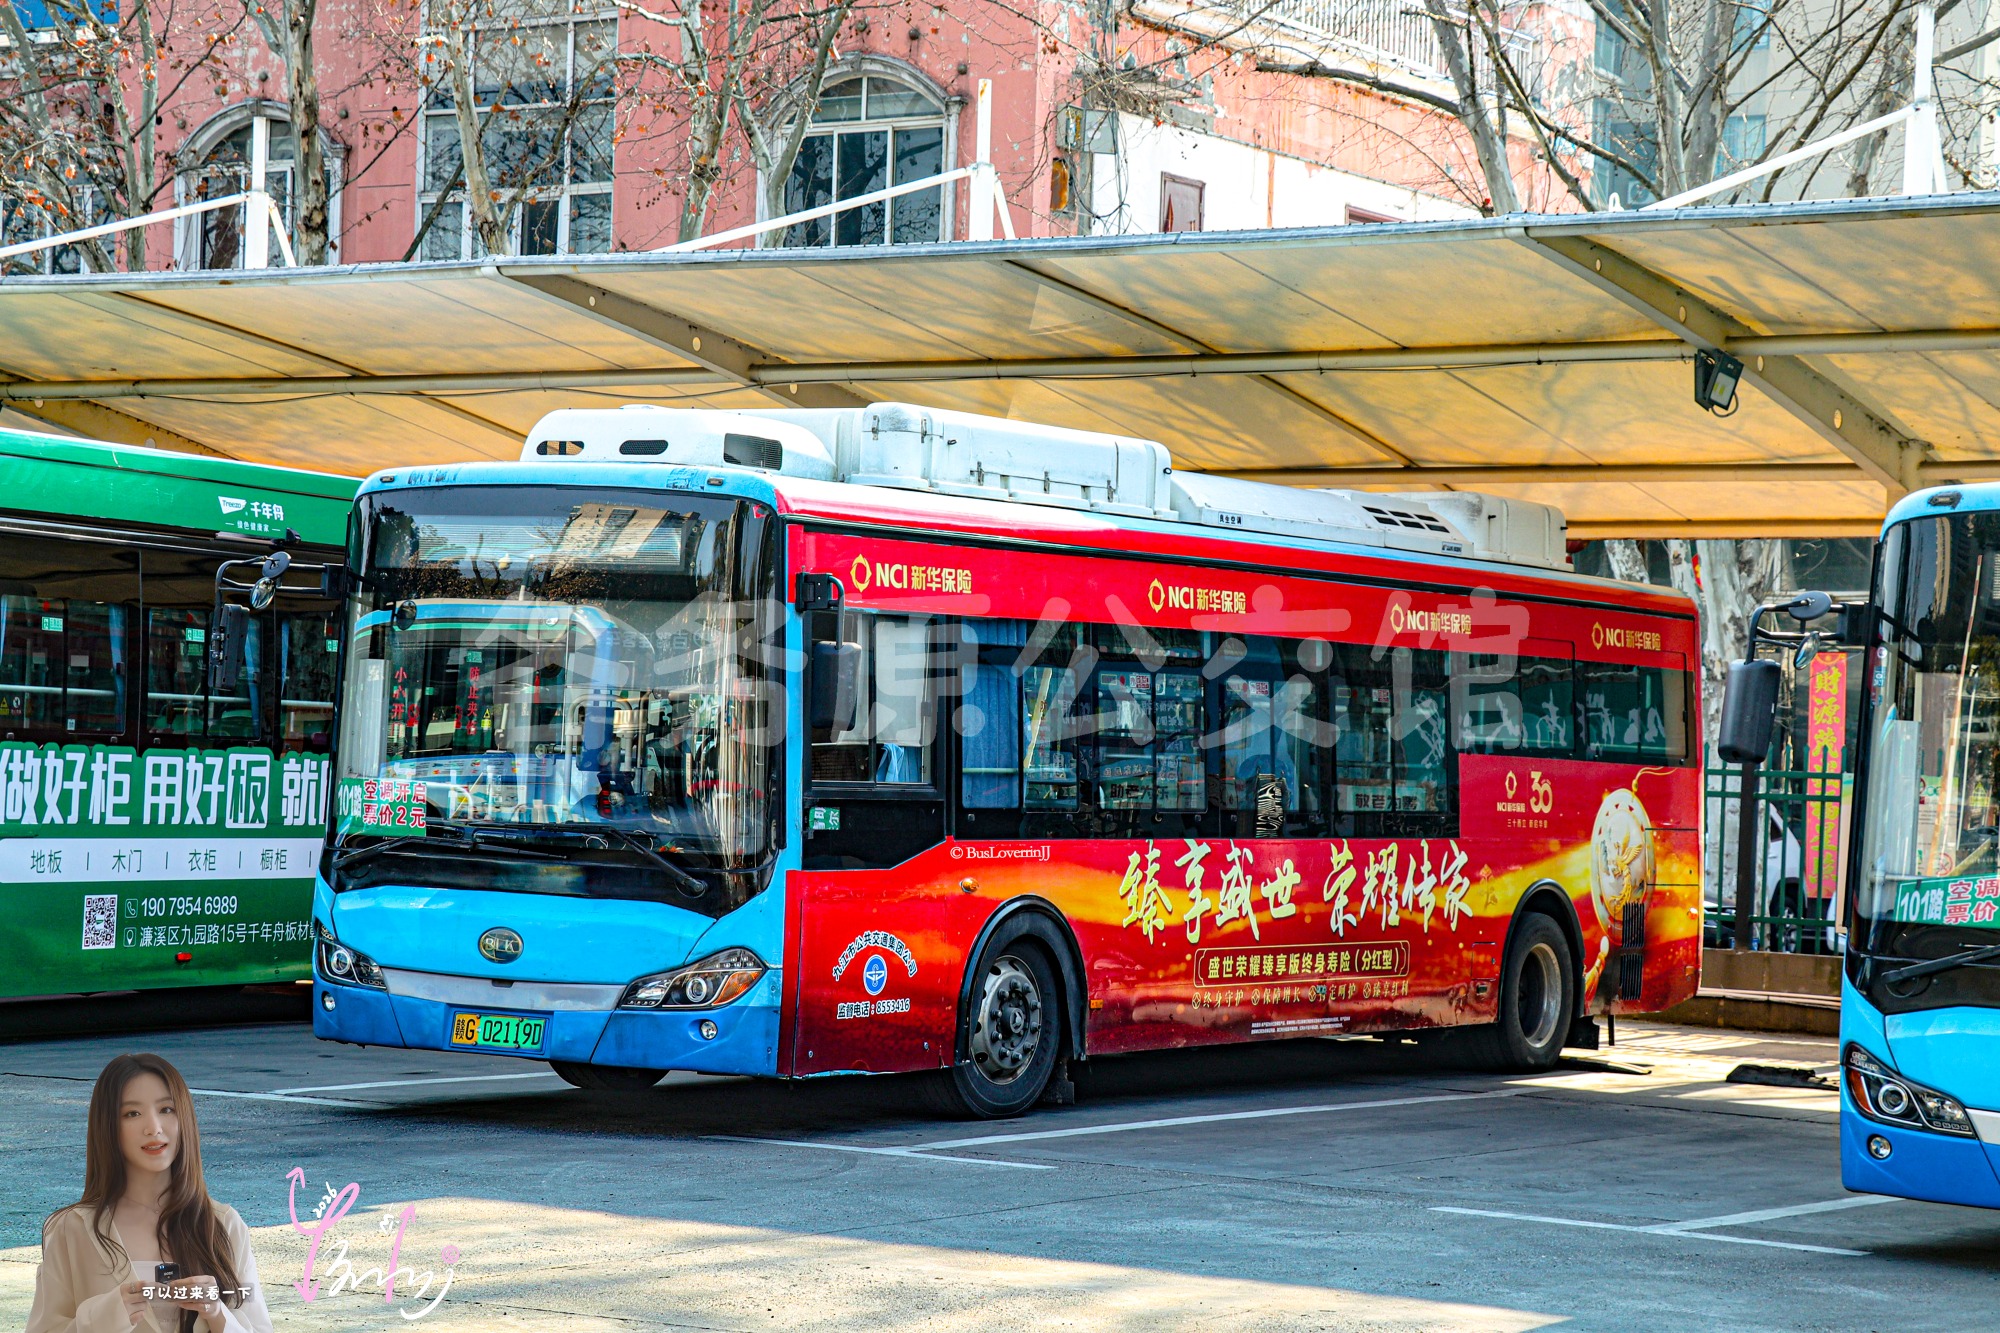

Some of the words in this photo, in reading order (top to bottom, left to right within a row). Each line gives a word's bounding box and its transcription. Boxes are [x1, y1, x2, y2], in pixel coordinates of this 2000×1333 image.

[250, 501, 284, 521] 千年舟
[876, 562, 908, 589] NCI
[911, 565, 972, 594] 新华保险
[1168, 585, 1194, 610] NCI
[1196, 588, 1247, 615] 新华保险
[1407, 609, 1429, 631] NCI
[1430, 612, 1472, 635] 新华保险
[1605, 627, 1625, 648] NCI
[1625, 630, 1661, 651] 新华保险
[0, 748, 133, 825] 做好柜
[143, 753, 271, 829] 用好板
[281, 757, 330, 826] 就
[338, 784, 362, 818] 101路
[364, 779, 427, 804] 空调开启
[363, 803, 426, 828] 票价2元
[30, 849, 62, 874] 地板
[112, 849, 142, 873] 木门
[188, 849, 217, 872] 衣柜
[260, 848, 288, 871] 橱柜
[1119, 838, 1301, 945] 臻享盛世
[1323, 838, 1473, 938] 荣耀传家
[1948, 879, 2000, 901] 空调
[141, 897, 166, 917] 190
[169, 896, 201, 916] 7954
[204, 896, 238, 915] 6989
[1900, 888, 1945, 922] 101路
[1944, 901, 1999, 925] 票价
[485, 938, 515, 953] BLK
[832, 930, 918, 982] 九江市公共交通集团公司
[1207, 950, 1351, 979] 盛世荣耀臻享版终身寿险
[1203, 989, 1244, 1008] 终身守护
[1263, 986, 1301, 1004] 保障增长
[482, 1020, 543, 1046] 02119D
